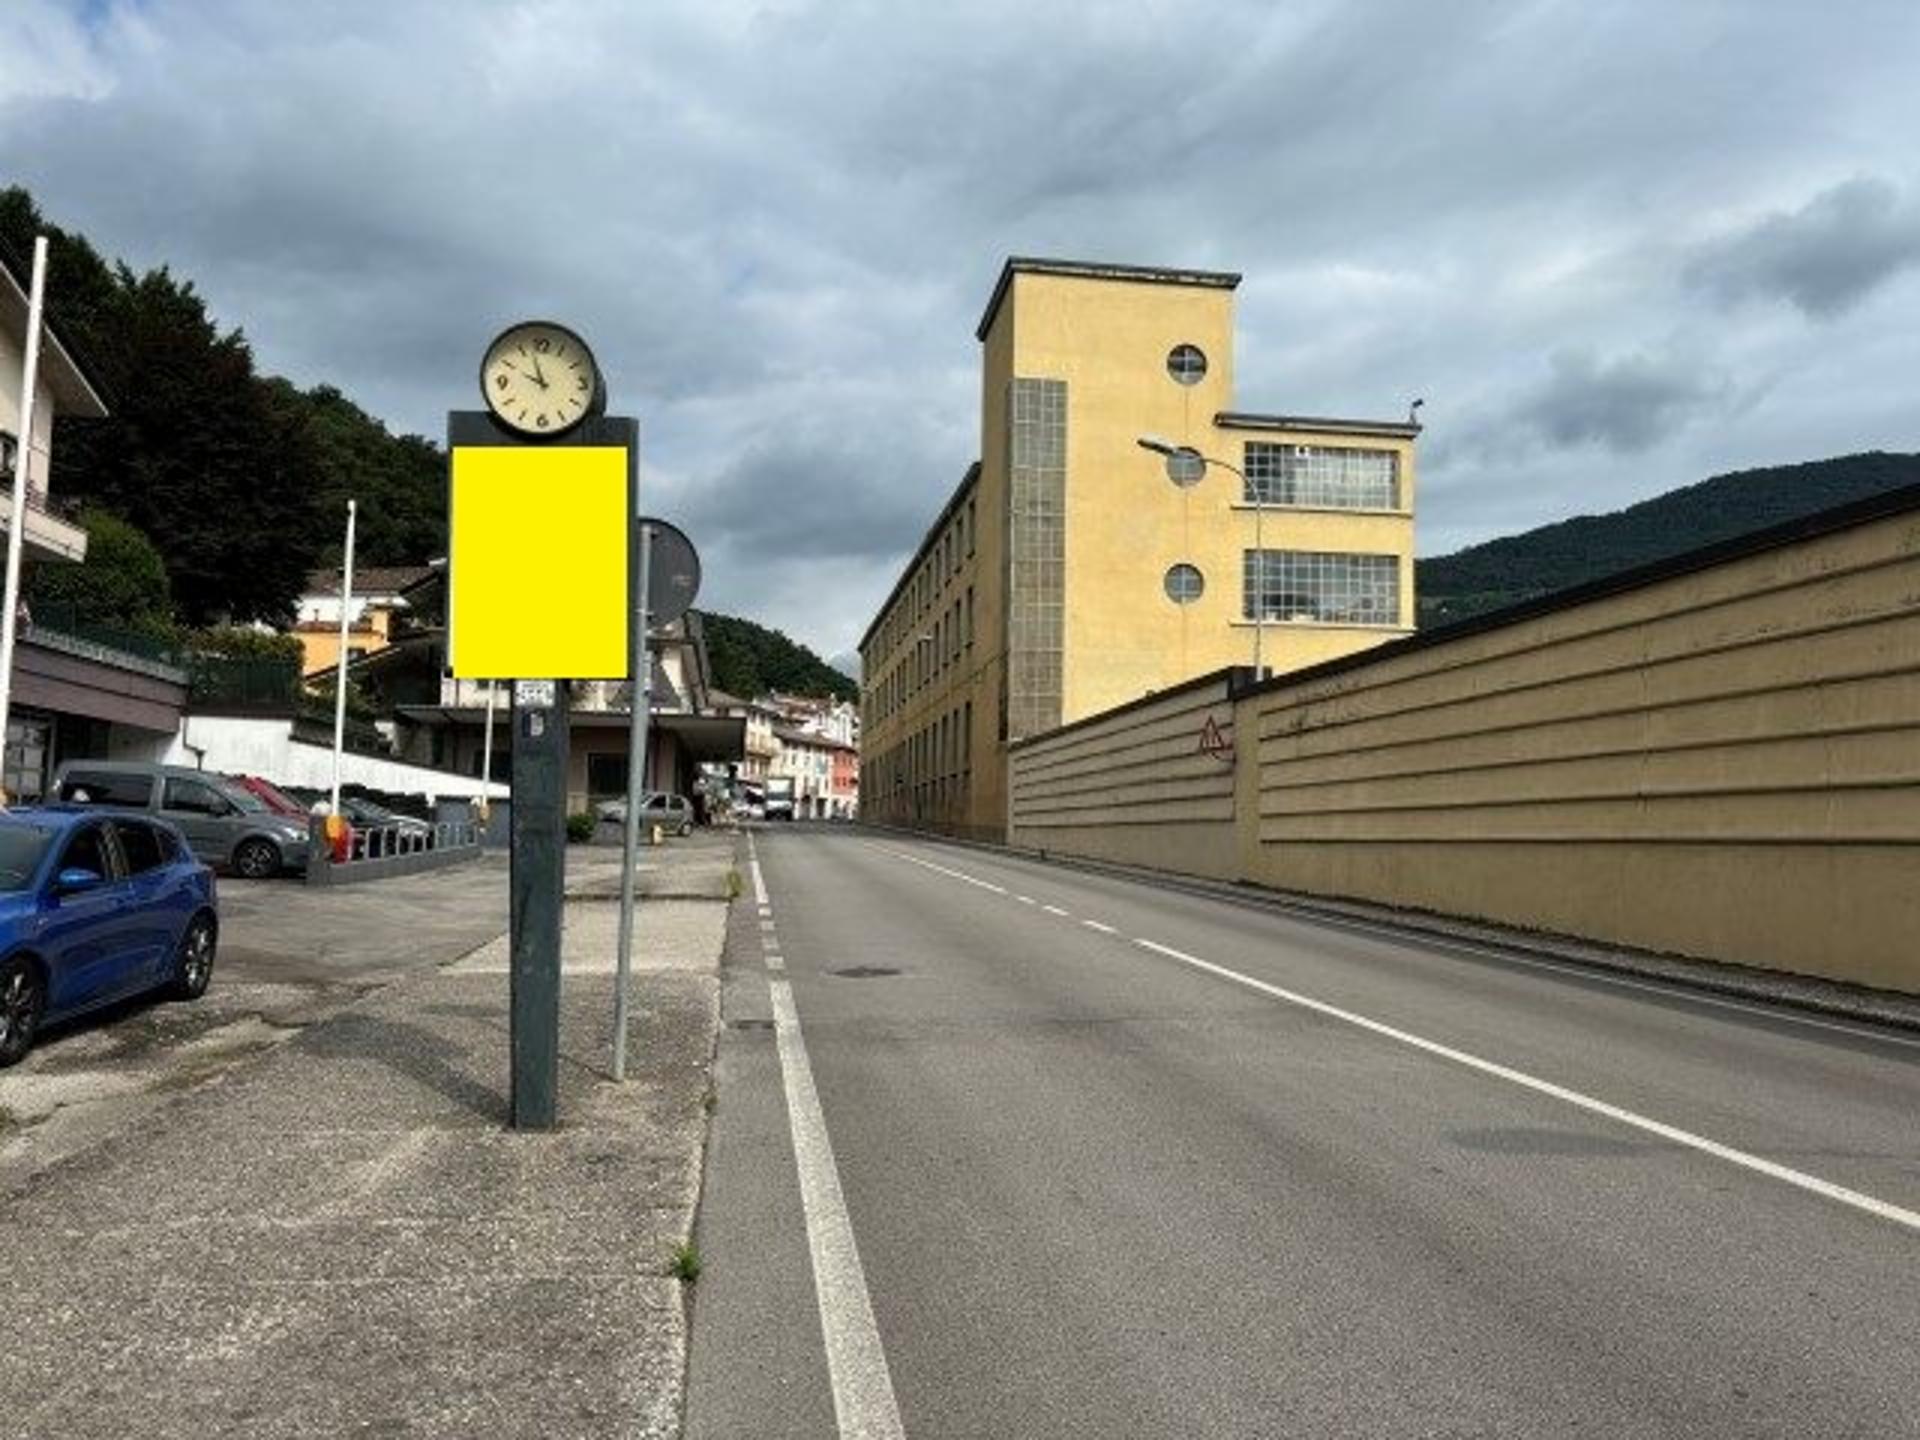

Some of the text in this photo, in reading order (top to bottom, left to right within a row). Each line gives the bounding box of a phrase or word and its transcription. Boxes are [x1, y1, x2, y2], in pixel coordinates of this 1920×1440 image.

[497, 375, 508, 390] 9
[578, 376, 589, 391] 3
[537, 414, 549, 427] 6
